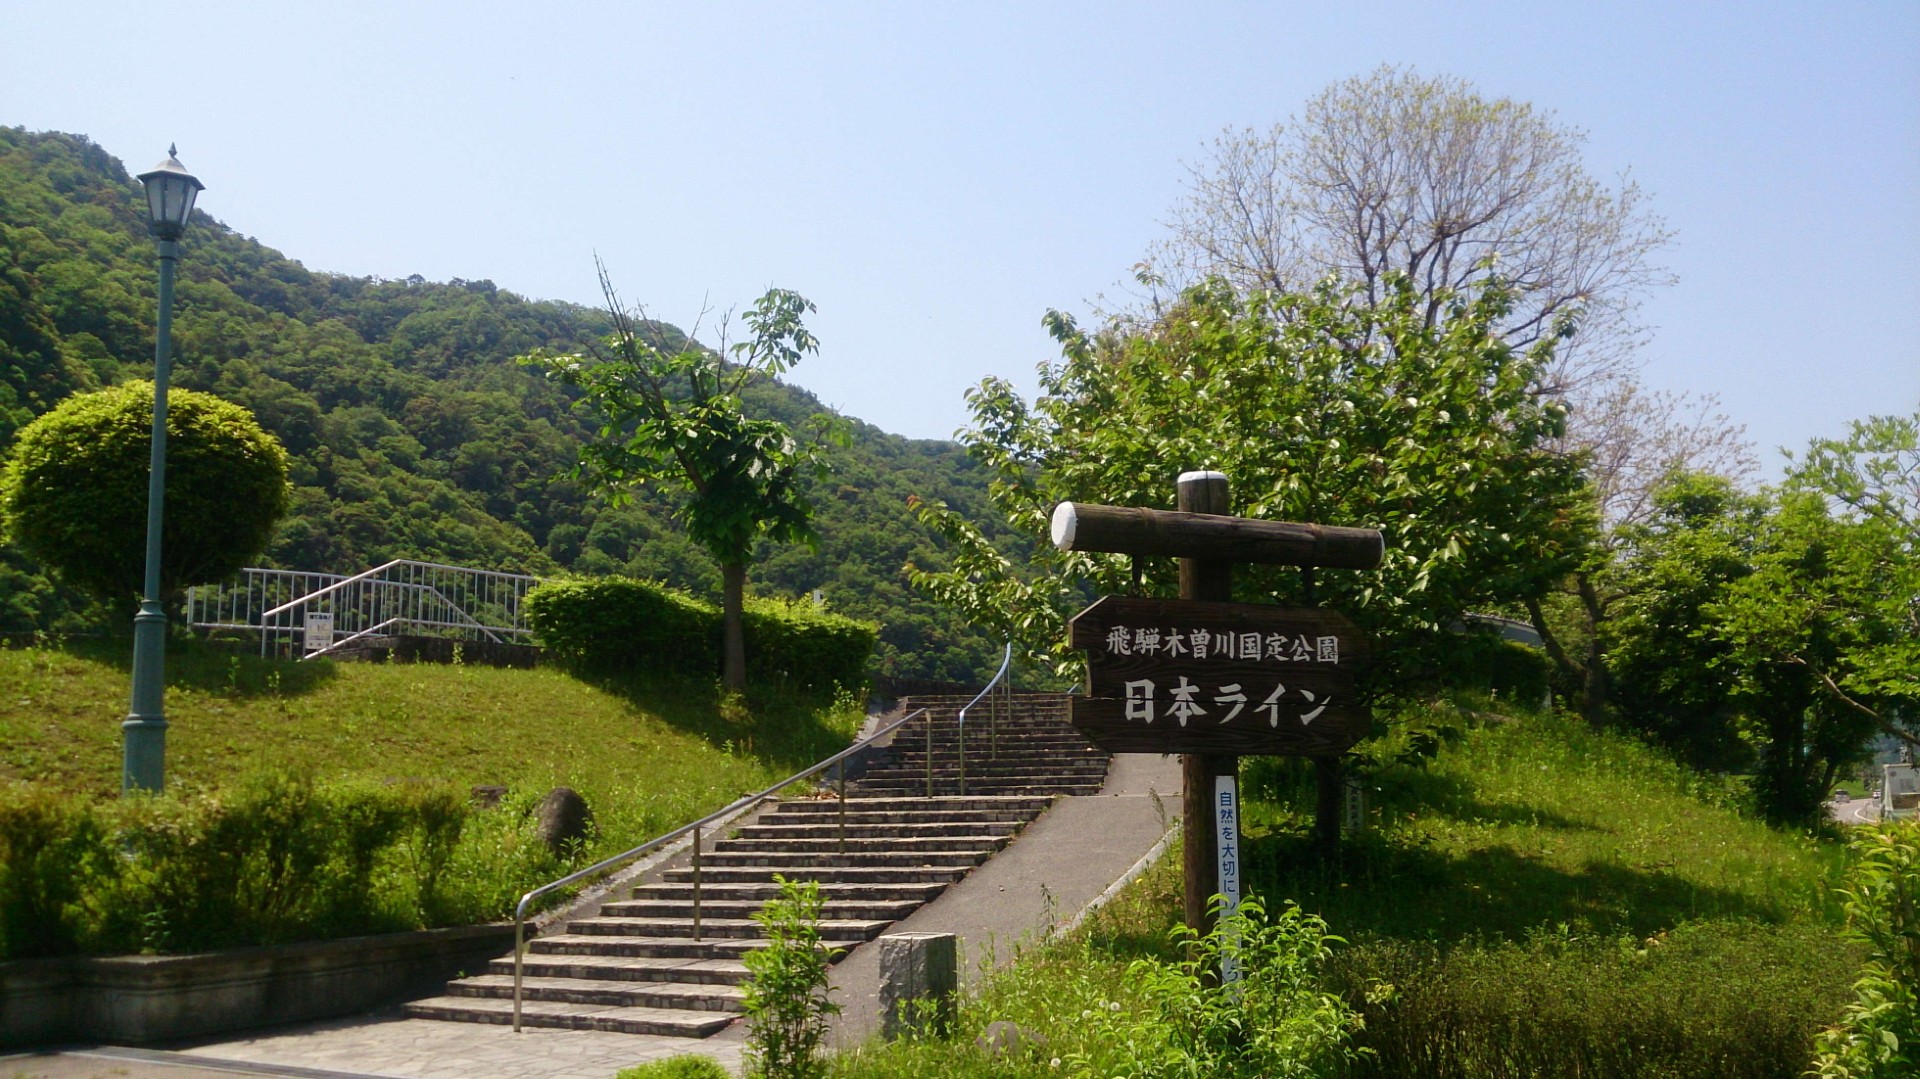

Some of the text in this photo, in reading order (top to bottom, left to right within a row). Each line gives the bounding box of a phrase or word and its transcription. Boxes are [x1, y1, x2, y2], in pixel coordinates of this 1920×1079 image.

[1105, 625, 1339, 665] 飛騨木曽川国定公園
[1125, 676, 1331, 728] 日本ライン
